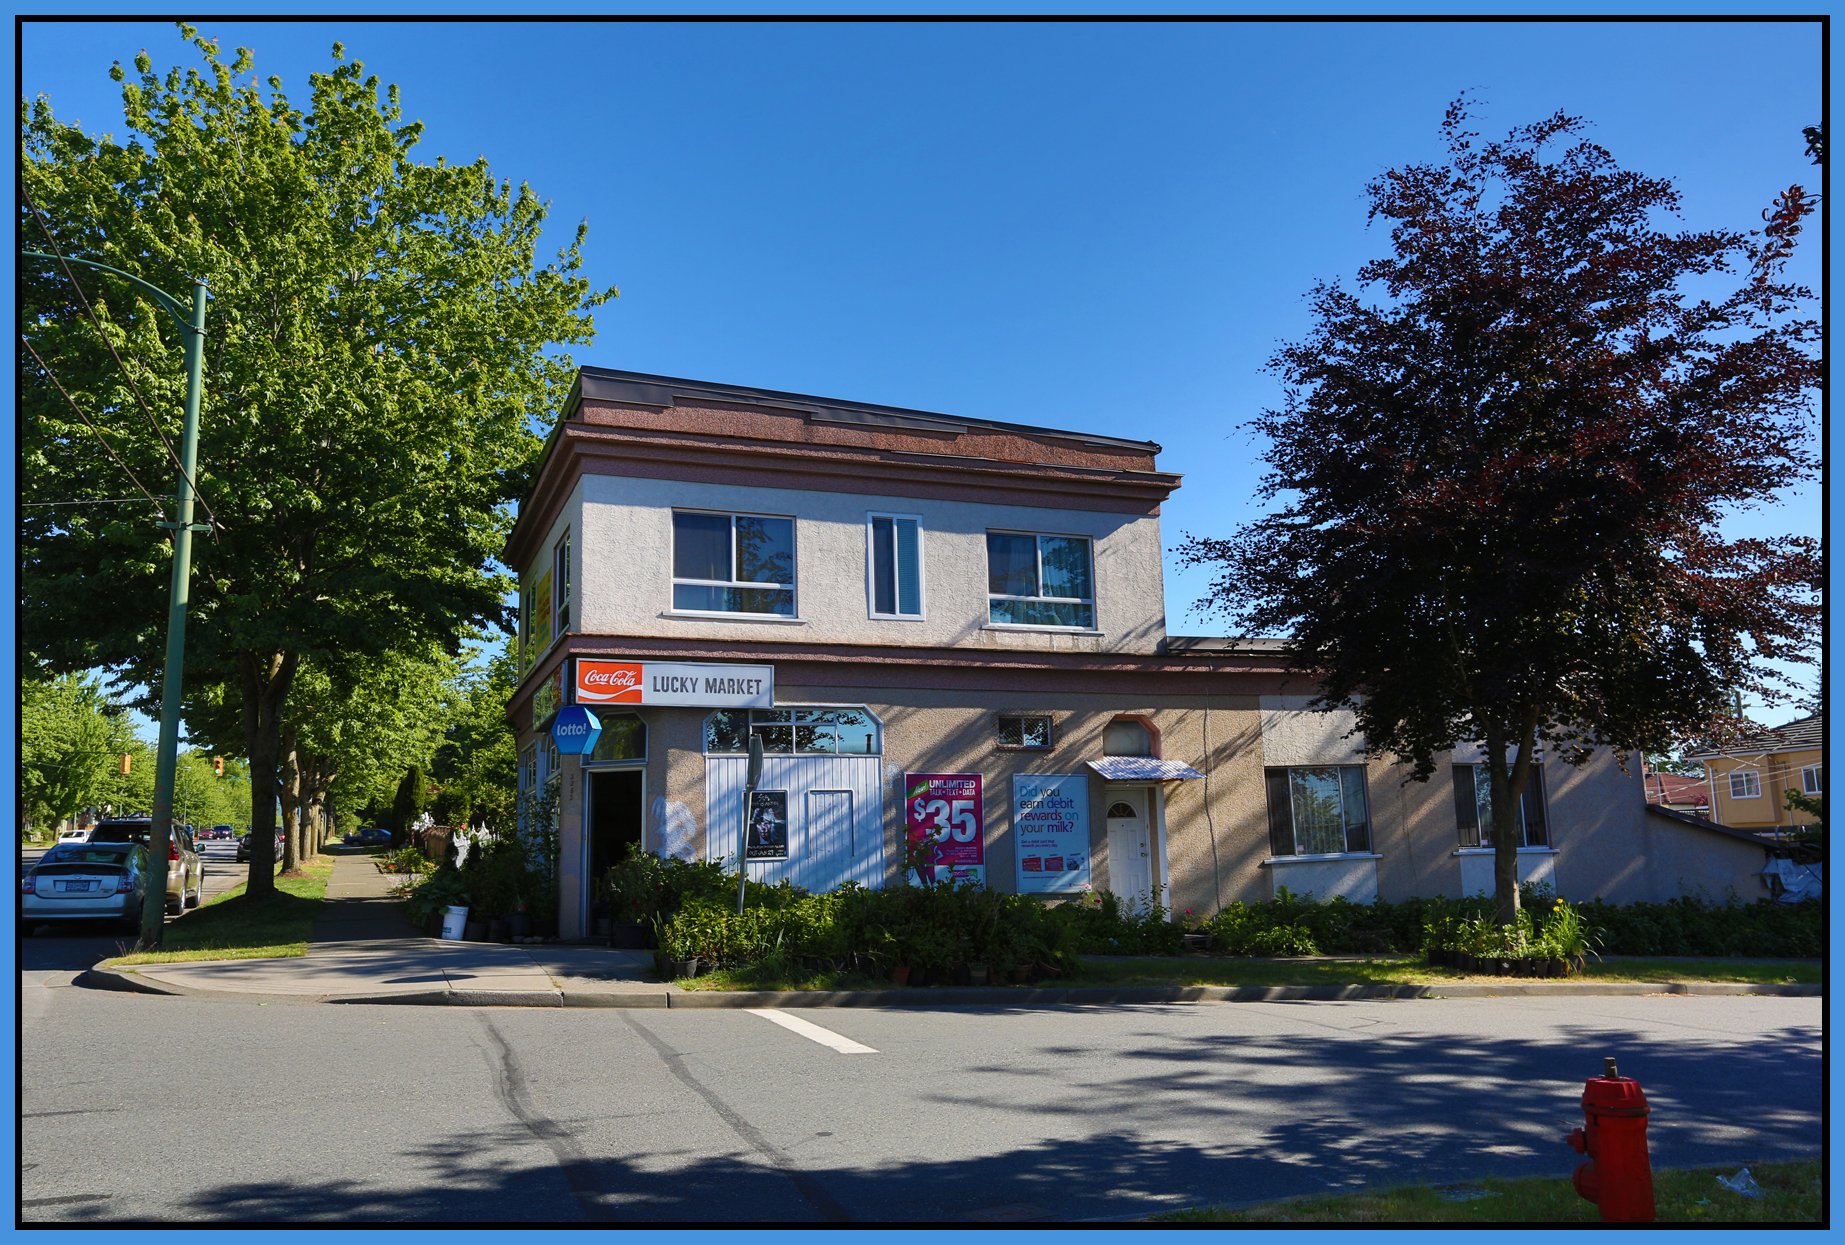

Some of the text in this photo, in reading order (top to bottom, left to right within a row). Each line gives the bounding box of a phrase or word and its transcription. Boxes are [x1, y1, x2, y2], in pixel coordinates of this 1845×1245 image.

[584, 669, 637, 686] Coca-Cola
[652, 675, 762, 695] LUCKY MARKET
[557, 722, 587, 736] lotto!
[928, 780, 976, 788] UNLIMITED
[929, 788, 976, 796] TALK TEXT DATA
[1020, 785, 1060, 799] Did you
[1020, 798, 1074, 809] earn debit
[913, 798, 977, 843] $35
[1020, 810, 1079, 821] rewards on
[1020, 821, 1074, 836] your milk?
